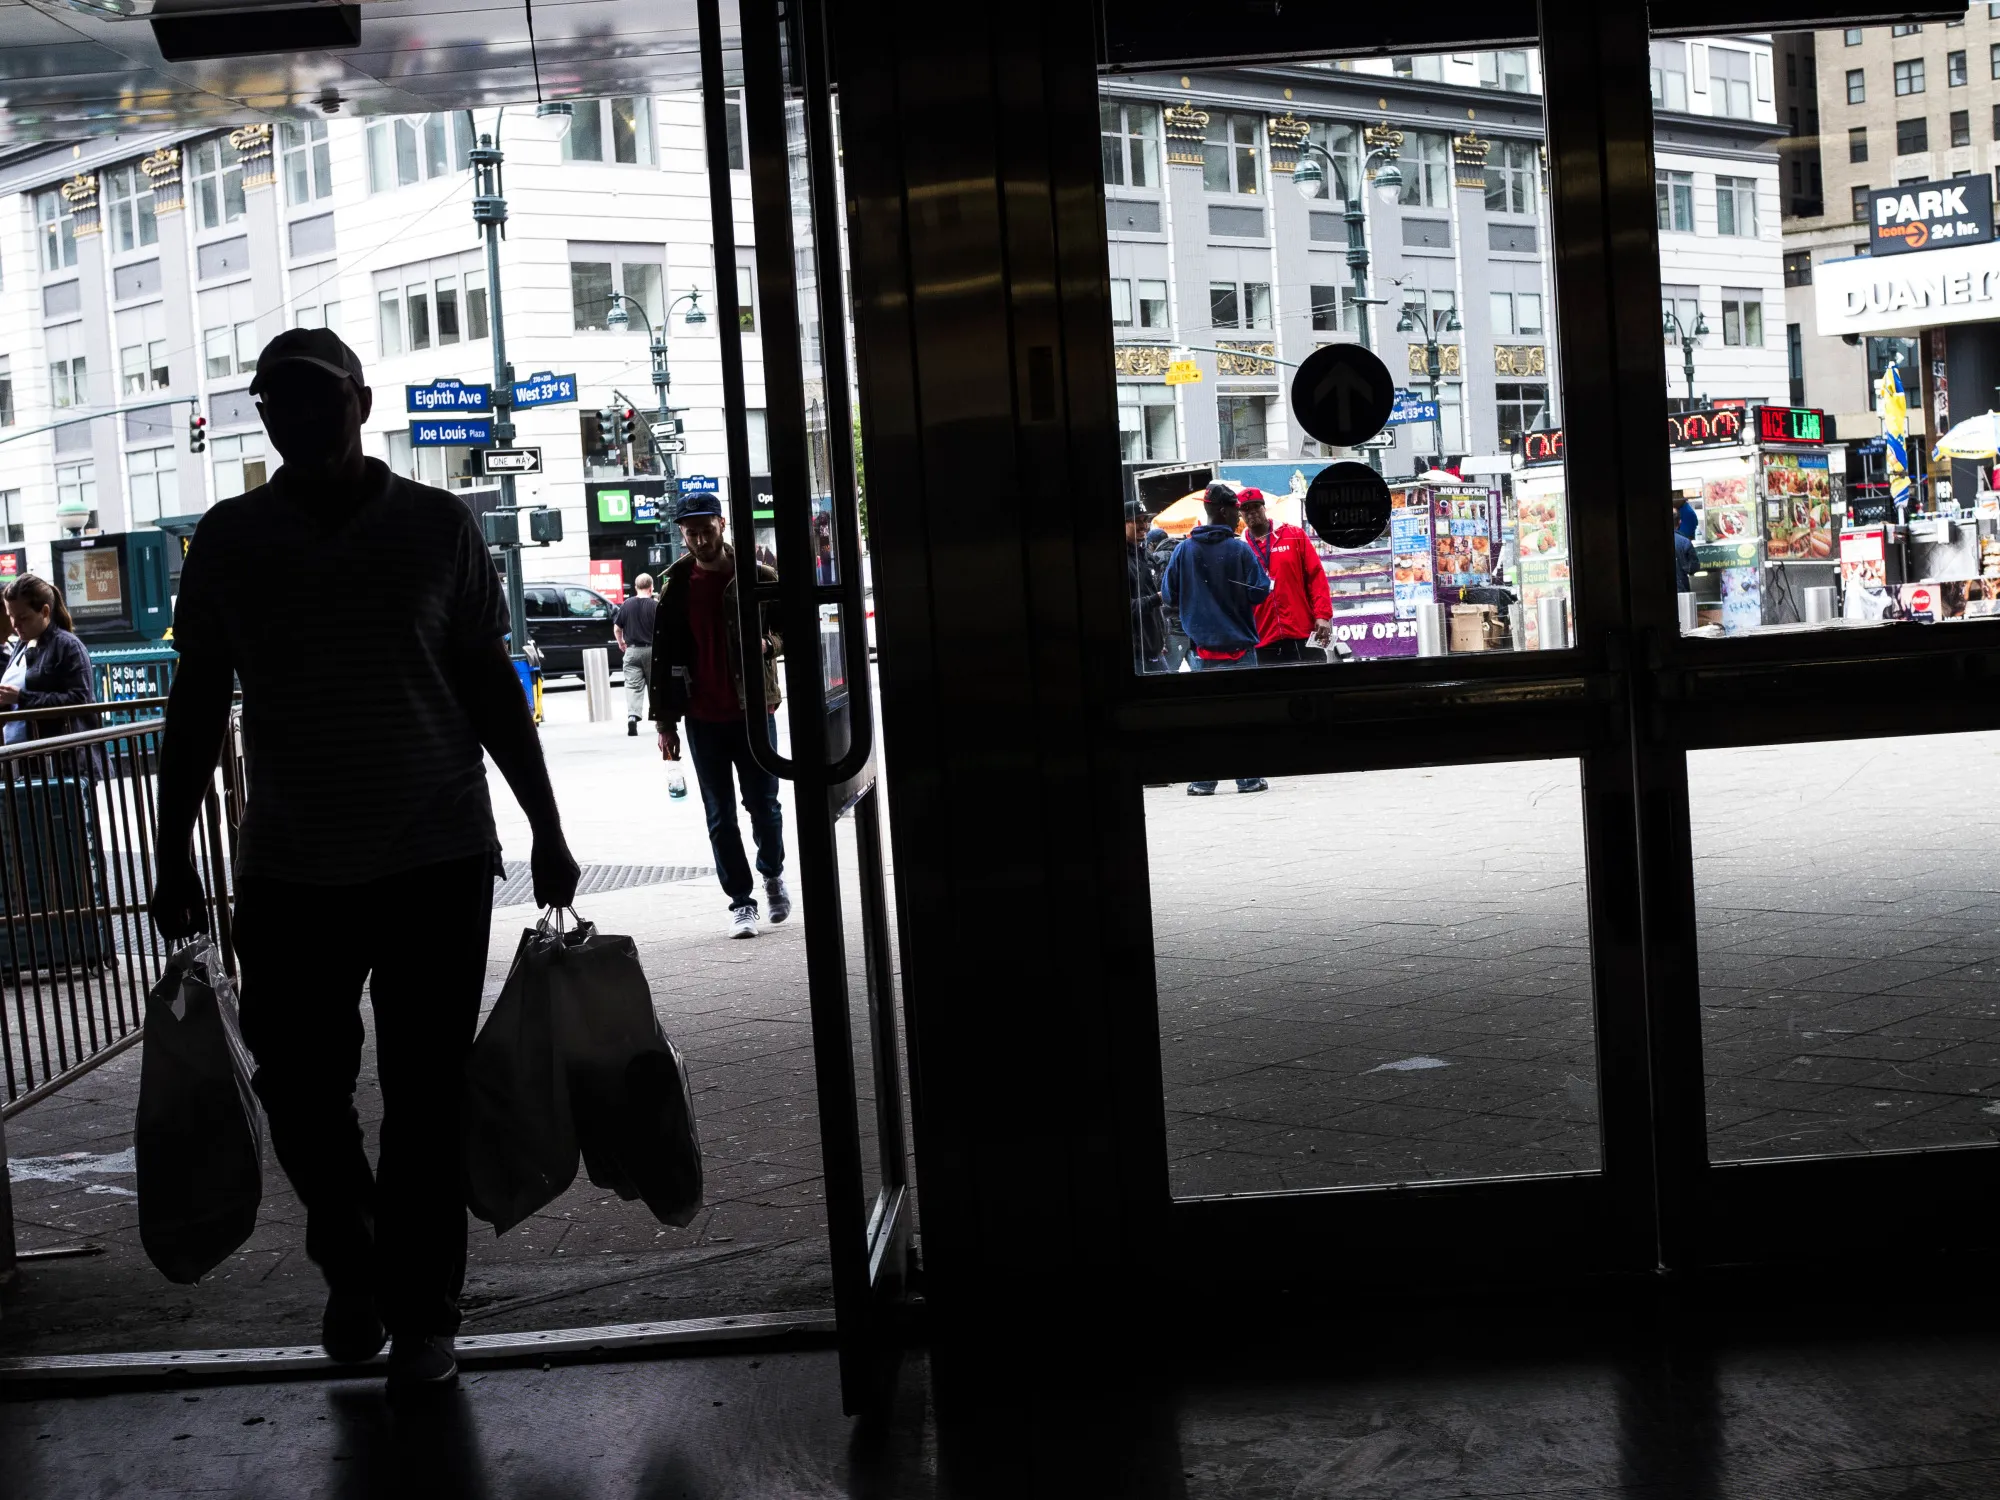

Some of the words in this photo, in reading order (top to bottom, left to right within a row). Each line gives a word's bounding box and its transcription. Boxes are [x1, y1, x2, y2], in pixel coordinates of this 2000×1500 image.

[1876, 186, 1969, 225] PARK
[1931, 222, 1954, 239] 24
[1956, 221, 1979, 236] hr.
[1843, 271, 1972, 317] DUANE
[415, 390, 455, 408] Eighth
[458, 391, 482, 405] Ave
[516, 387, 540, 402] West
[541, 382, 558, 399] 33rd
[559, 381, 570, 396] St
[1407, 406, 1423, 418] 33rd
[1425, 406, 1434, 417] St
[419, 427, 437, 440] Joe
[439, 425, 466, 440] Louis
[469, 429, 485, 438] Plaza
[1792, 413, 1820, 440] LAMB
[493, 456, 508, 466] ONE
[515, 455, 531, 465] WAY
[682, 480, 702, 491] Eighth
[703, 480, 715, 489] Ave
[1440, 487, 1461, 495] NOW
[1462, 486, 1488, 495] OPEN!
[1316, 485, 1381, 505] MANUAL
[603, 495, 628, 516] TD
[638, 508, 650, 517] West
[625, 539, 637, 547] 461
[96, 569, 113, 580] Lines
[1372, 621, 1418, 639] OPEN
[112, 667, 122, 680] 34
[113, 681, 130, 693] Pen
